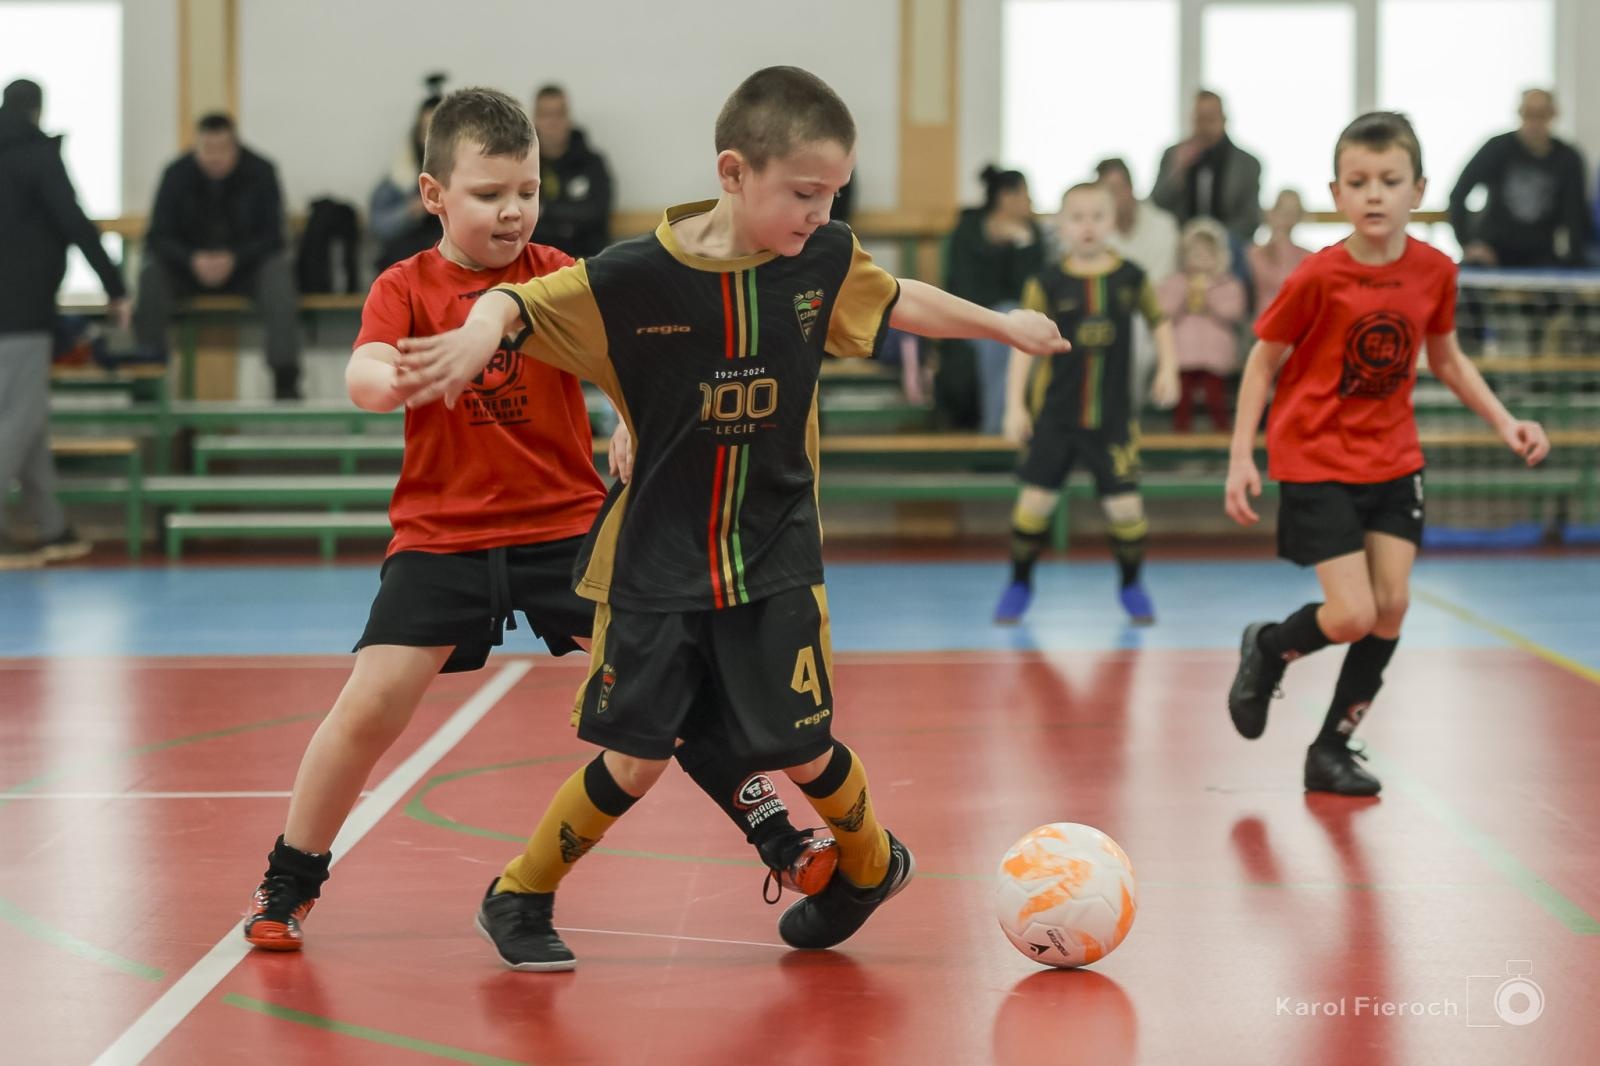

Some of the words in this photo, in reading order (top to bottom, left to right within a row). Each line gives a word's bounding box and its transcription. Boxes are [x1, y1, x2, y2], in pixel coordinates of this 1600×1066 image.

[636, 324, 692, 335] regio
[715, 367, 766, 379] 1924-2024
[699, 378, 778, 422] 100
[715, 423, 757, 435] LECIE
[790, 645, 823, 707] 4
[795, 708, 830, 729] regio
[747, 798, 784, 823] AKADEM
